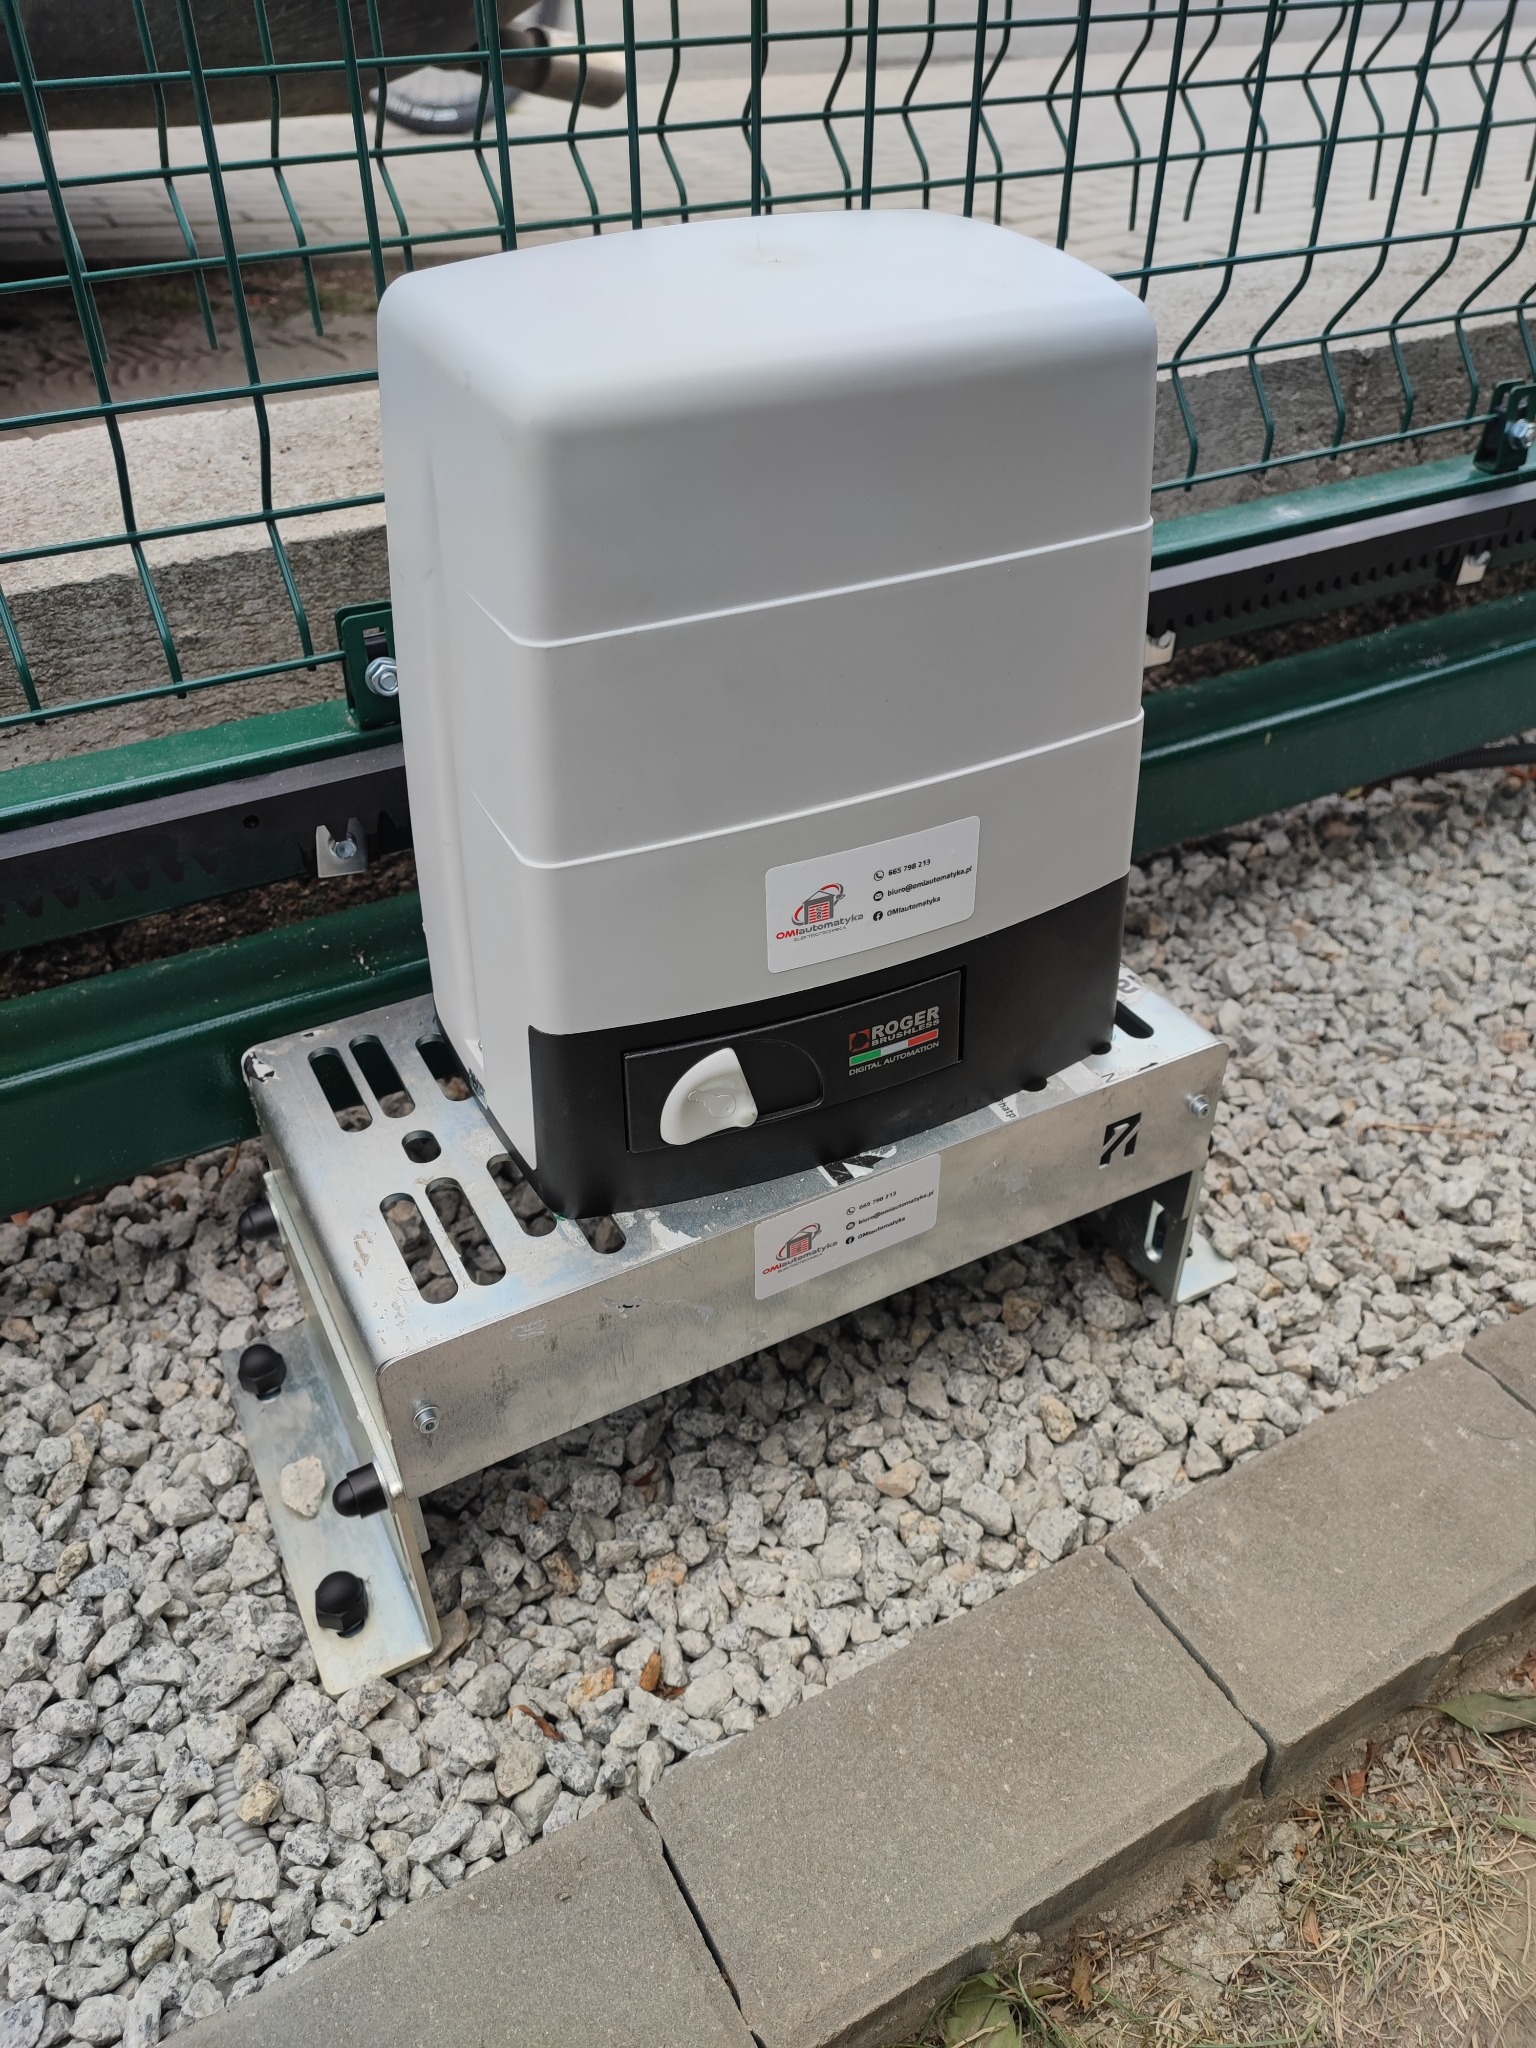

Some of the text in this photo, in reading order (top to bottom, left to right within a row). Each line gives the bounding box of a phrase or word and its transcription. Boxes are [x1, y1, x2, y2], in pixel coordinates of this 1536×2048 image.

[887, 865, 972, 897] biuro@omiautomatyka.pl
[888, 858, 931, 876] 665 798 213
[776, 913, 864, 940] OMIautomatyka
[871, 1006, 940, 1040] ROGER
[871, 1019, 940, 1047] BRUSHLESS
[848, 1041, 940, 1077] DIGITAL AUTOMATION
